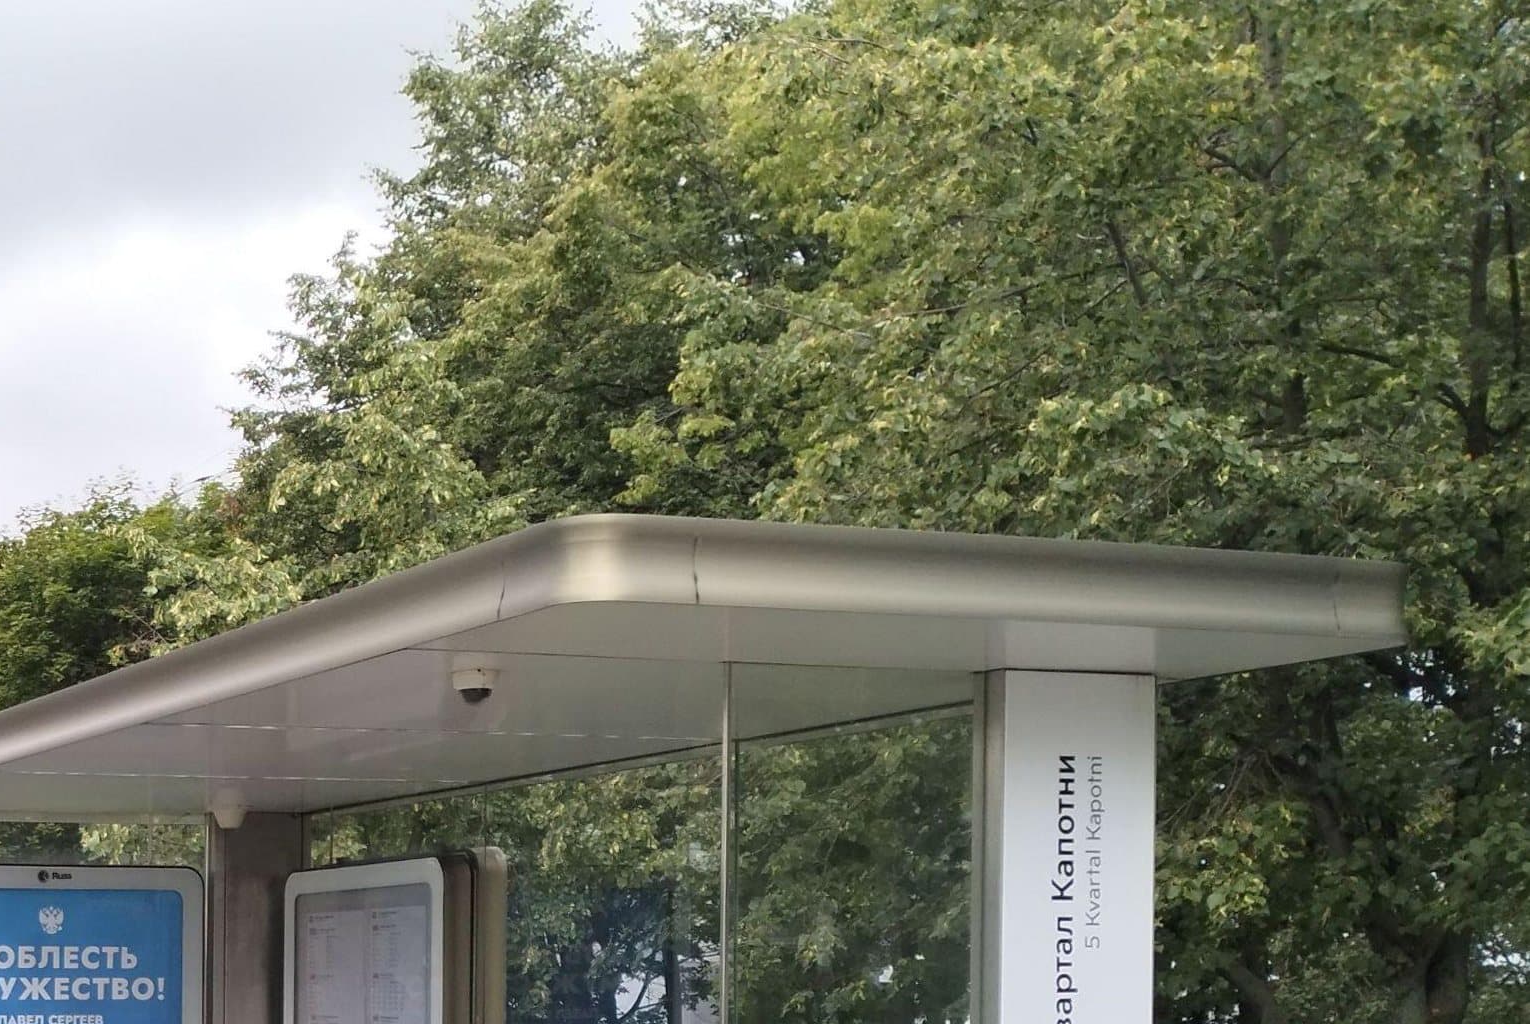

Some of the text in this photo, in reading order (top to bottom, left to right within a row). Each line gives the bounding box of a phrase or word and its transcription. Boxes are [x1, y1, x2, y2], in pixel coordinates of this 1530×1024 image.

[1051, 755, 1075, 900] Капотни
[1085, 756, 1105, 949] 5 Kvartal Kapotni
